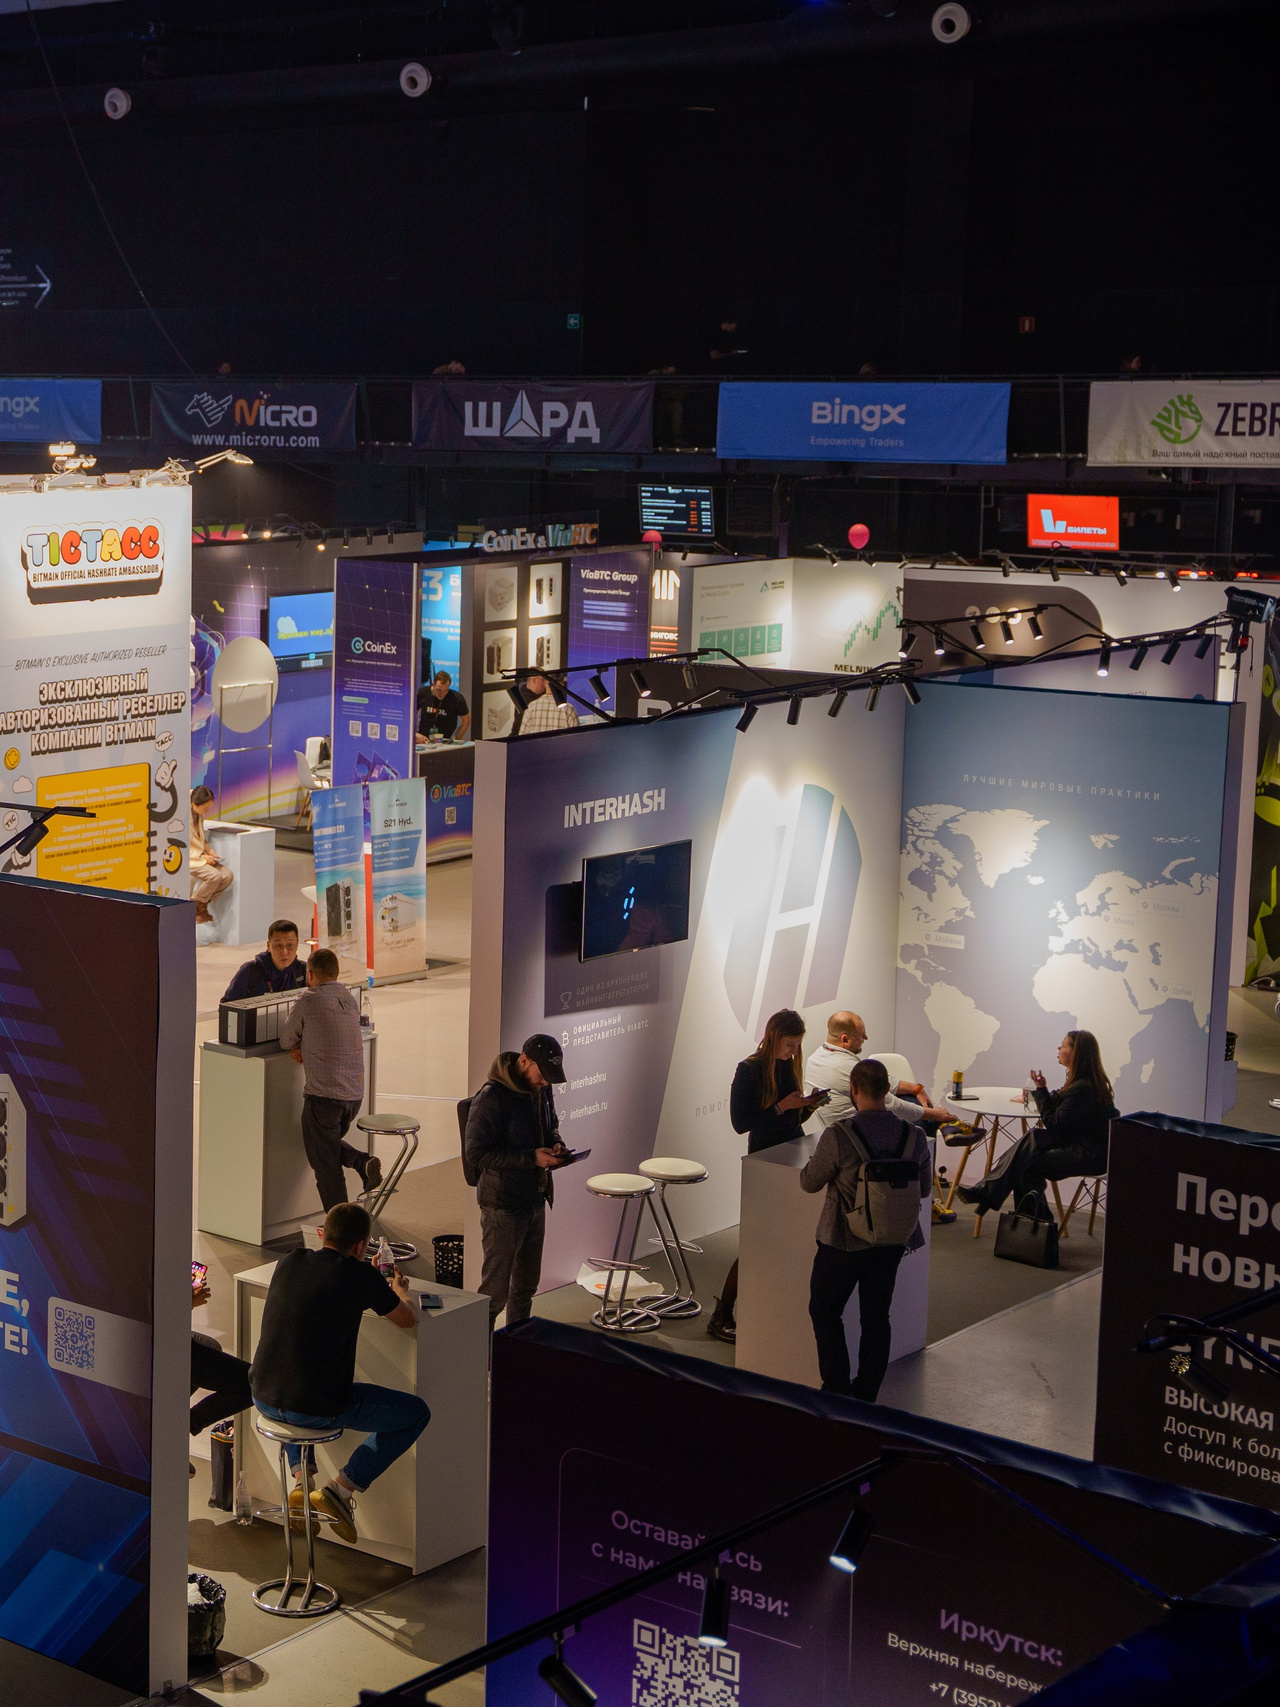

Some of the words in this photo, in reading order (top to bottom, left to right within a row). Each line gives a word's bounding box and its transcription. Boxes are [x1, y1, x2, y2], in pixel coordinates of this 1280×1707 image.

[463, 389, 600, 444] ШАРД
[192, 432, 320, 448] www.microru.com
[810, 436, 867, 450] Empowering
[868, 437, 905, 448] Traders
[1173, 450, 1201, 458] самый
[26, 525, 160, 567] TICTACC
[482, 528, 537, 553] CoinEx
[537, 535, 547, 548] &
[546, 523, 600, 548] ViaBTC
[32, 571, 59, 583] BITMAIN
[60, 569, 87, 581] OFFICIAL
[87, 567, 118, 579] HASHRATE
[118, 563, 159, 577] AMBASSADOR
[580, 568, 612, 582] ViaBTC
[612, 570, 638, 585] Group
[14, 656, 51, 671] BITMAIN'S
[51, 652, 89, 668] EXCLUSIVE
[89, 648, 134, 664] AUTHORIZED
[134, 644, 168, 659] RESELLER
[364, 640, 398, 656] CoinEx
[39, 668, 149, 705] ЭКСКЛЮЗИВНЫЙ
[121, 691, 186, 720] РЕСЕЛЛЕР
[31, 725, 102, 757] КОМПАНИИ
[104, 718, 157, 748] BITMAIN
[155, 733, 174, 747] TACC
[443, 782, 472, 799] ViaBTC
[963, 773, 1013, 787] ЛУЧШИЕ
[1021, 779, 1083, 795] МИРОВЫЕ
[1091, 785, 1161, 801] ПРАКТИКИ
[563, 787, 667, 829] INTERHASH
[4, 813, 18, 828] TIC
[383, 818, 397, 829] S21
[398, 816, 414, 828] Hyd.
[1152, 902, 1180, 915] Москва
[1114, 915, 1135, 927] Минск
[576, 985, 594, 997] ОДИН
[596, 981, 605, 992] ИЗ
[606, 971, 648, 990] КРУПНЕЙШИХ
[1171, 985, 1192, 998] Дубай
[573, 1014, 622, 1035] ОФИЦИАЛЬНЫЙ
[573, 1024, 625, 1047] ПРЕДСТАВИТЕЛЬ
[627, 1019, 650, 1035] VIABTC
[570, 1101, 608, 1120] interhash.ru
[1163, 1385, 1275, 1433] ВЫСОКАЯ
[1163, 1414, 1225, 1446] Доступ
[1232, 1436, 1242, 1449] к
[1163, 1440, 1173, 1455] с
[591, 1542, 604, 1558] с
[677, 1571, 706, 1592] на
[939, 1608, 1063, 1668] Иркутск:
[887, 1631, 960, 1669] Верхняя
[963, 1660, 1048, 1695] набереж
[928, 1681, 950, 1699] +7
